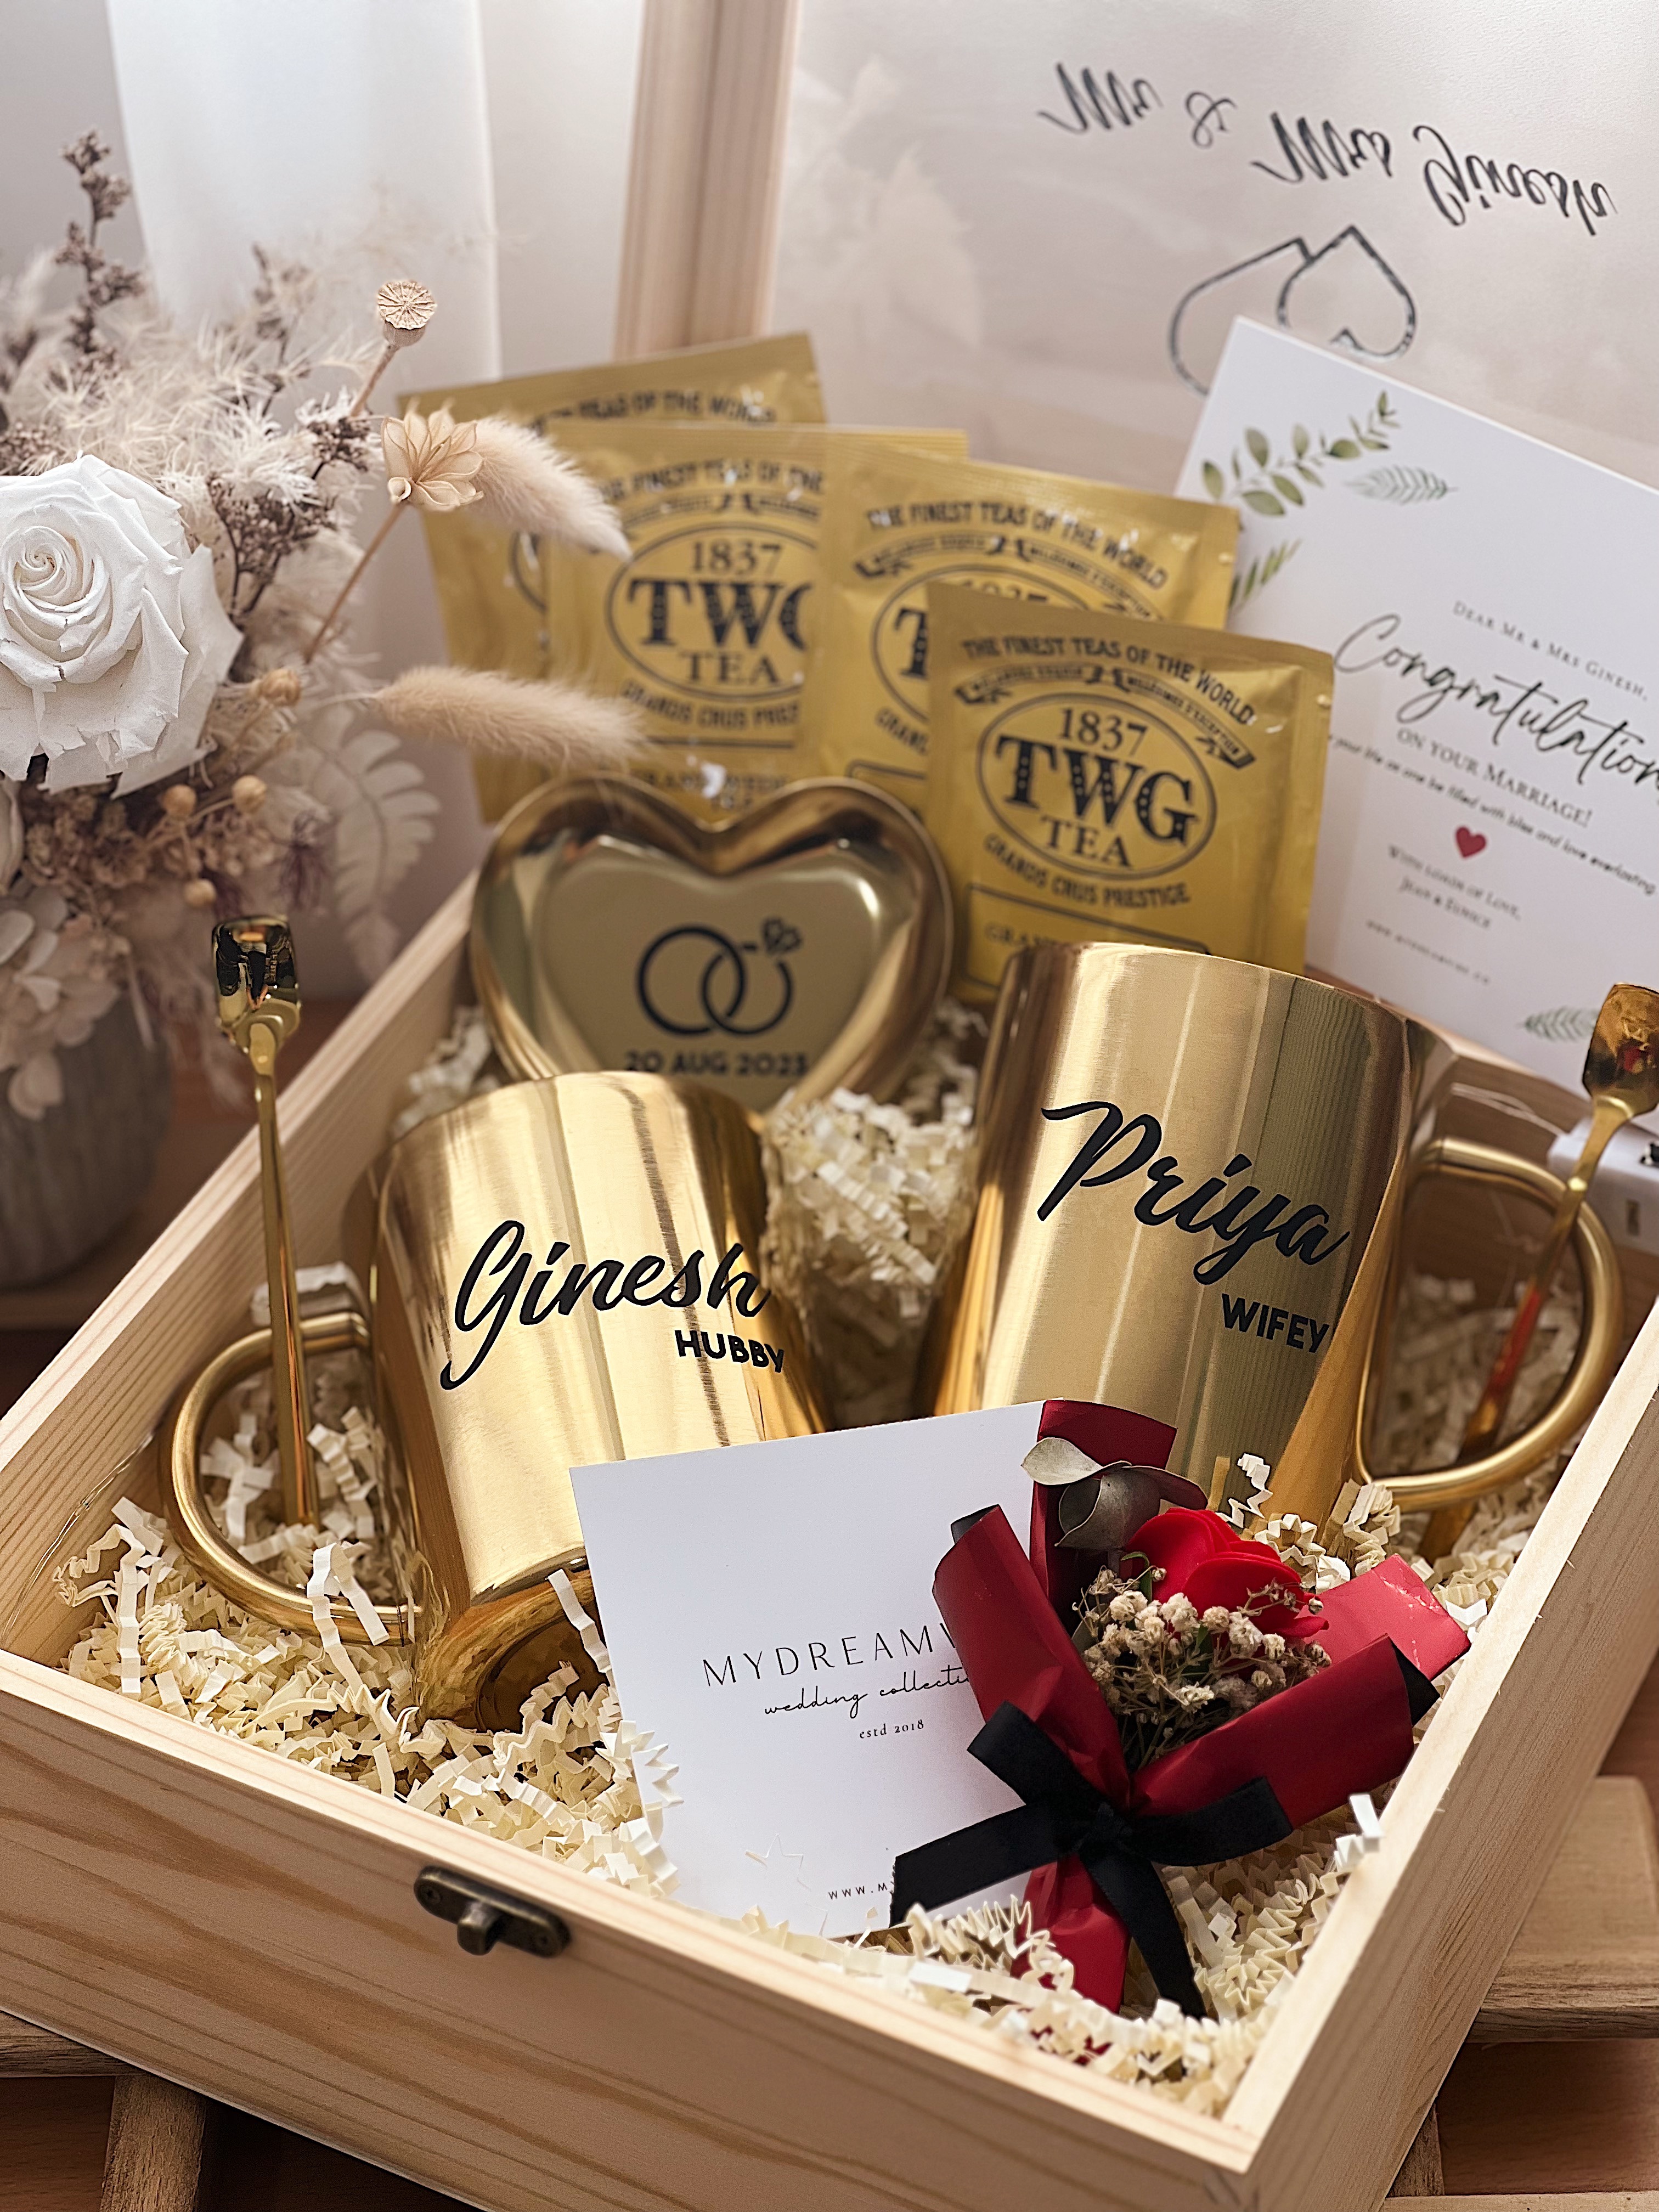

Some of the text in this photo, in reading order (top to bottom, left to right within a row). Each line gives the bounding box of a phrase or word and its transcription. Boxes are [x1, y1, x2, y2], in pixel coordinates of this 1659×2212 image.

[757, 460, 781, 482] OF
[691, 540, 782, 578] 1837
[910, 501, 973, 525] FINEST
[980, 501, 1028, 527] TEAS
[1032, 510, 1058, 532] OF
[1103, 531, 1169, 590] WORLD
[679, 651, 782, 686] TEA
[962, 635, 1254, 727] THE FINEST TEAS OF THE WORLD
[1060, 706, 1148, 757] 1837
[993, 734, 1200, 848] TWG
[1402, 767, 1425, 783] one
[1427, 774, 1444, 792] be
[1447, 785, 1480, 810] filled
[1536, 829, 1563, 848] and
[1563, 837, 1588, 859] love
[984, 833, 1192, 910] GRANDS CRUS PRESTIGE
[1041, 812, 1133, 872] TEA
[673, 1051, 727, 1075] AUG
[1037, 1101, 1351, 1285] Priya
[440, 1220, 771, 1391] Ginesh
[1221, 1293, 1330, 1354] WIFEY
[674, 1329, 785, 1373] HUBBY
[764, 1664, 969, 1719] wedding collecti
[859, 1718, 924, 1739] estd 2018
